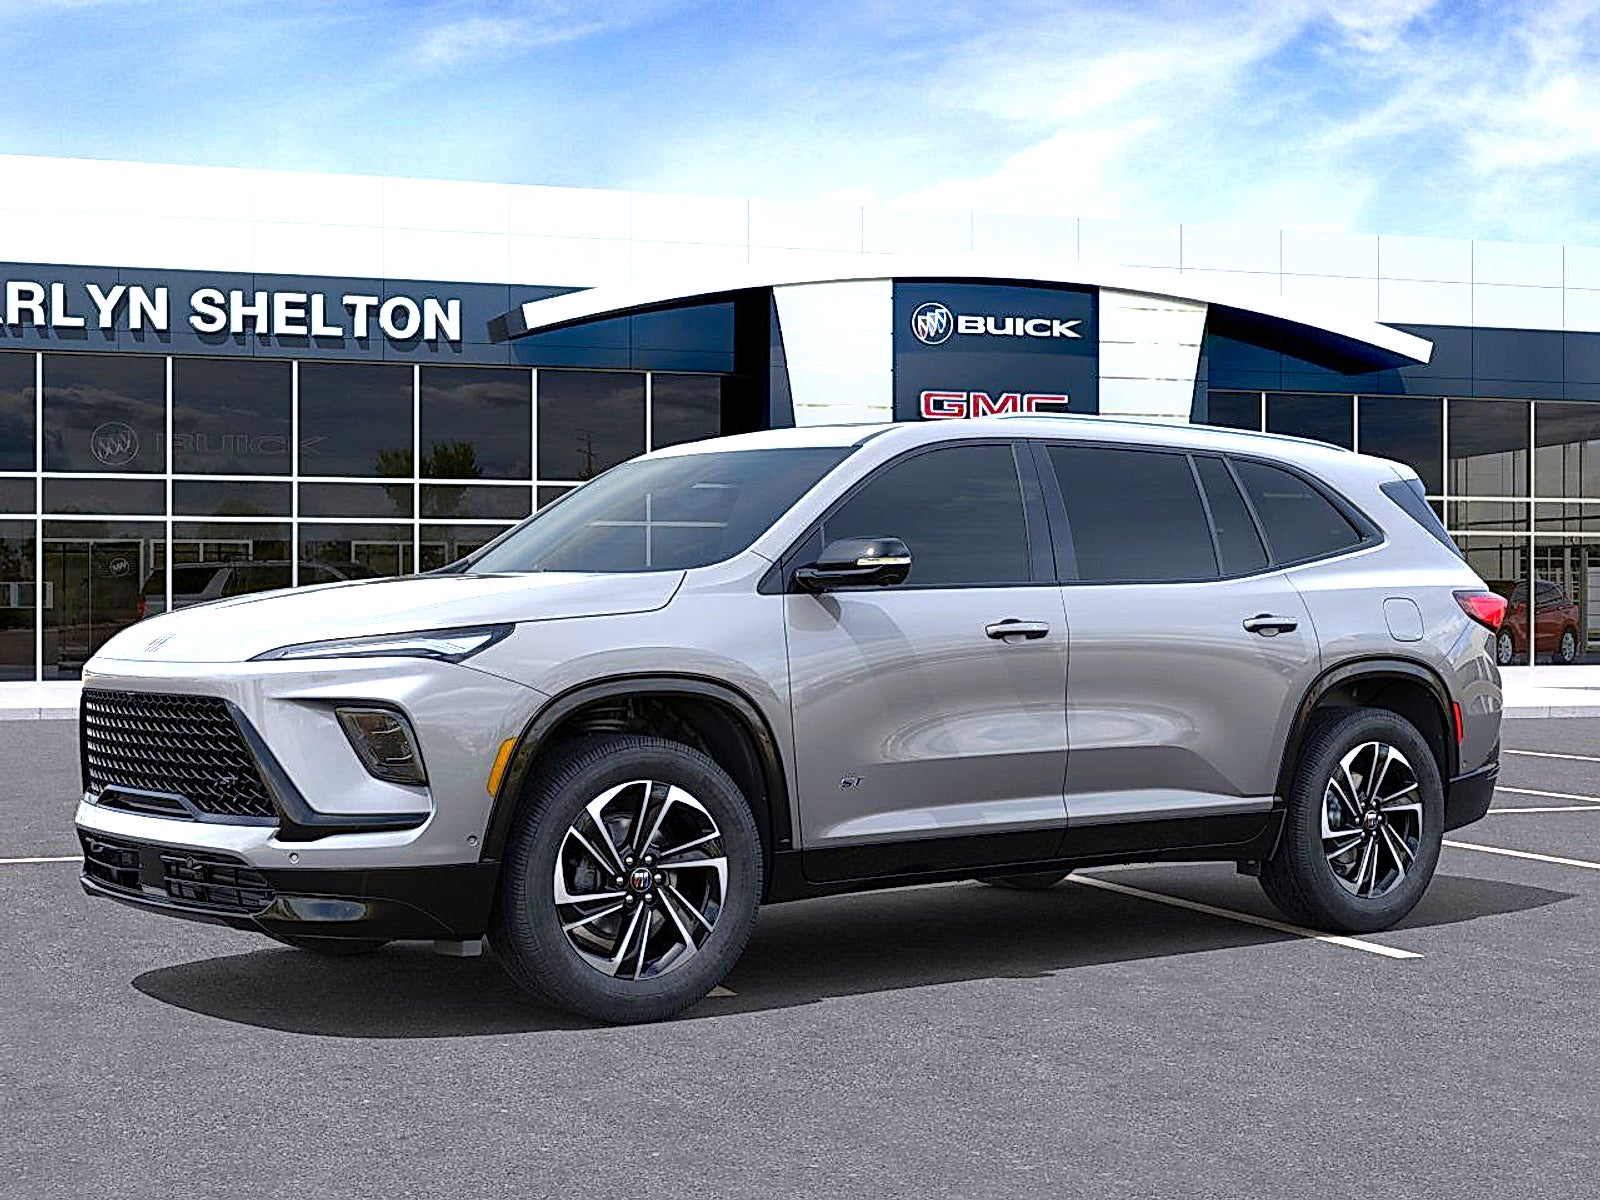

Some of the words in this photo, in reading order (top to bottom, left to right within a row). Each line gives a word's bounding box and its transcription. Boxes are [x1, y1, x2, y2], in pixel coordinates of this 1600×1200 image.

[0, 281, 168, 330] RLYN
[189, 288, 460, 341] SHELTON
[957, 315, 1082, 338] BUICK
[920, 390, 1069, 419] GMC
